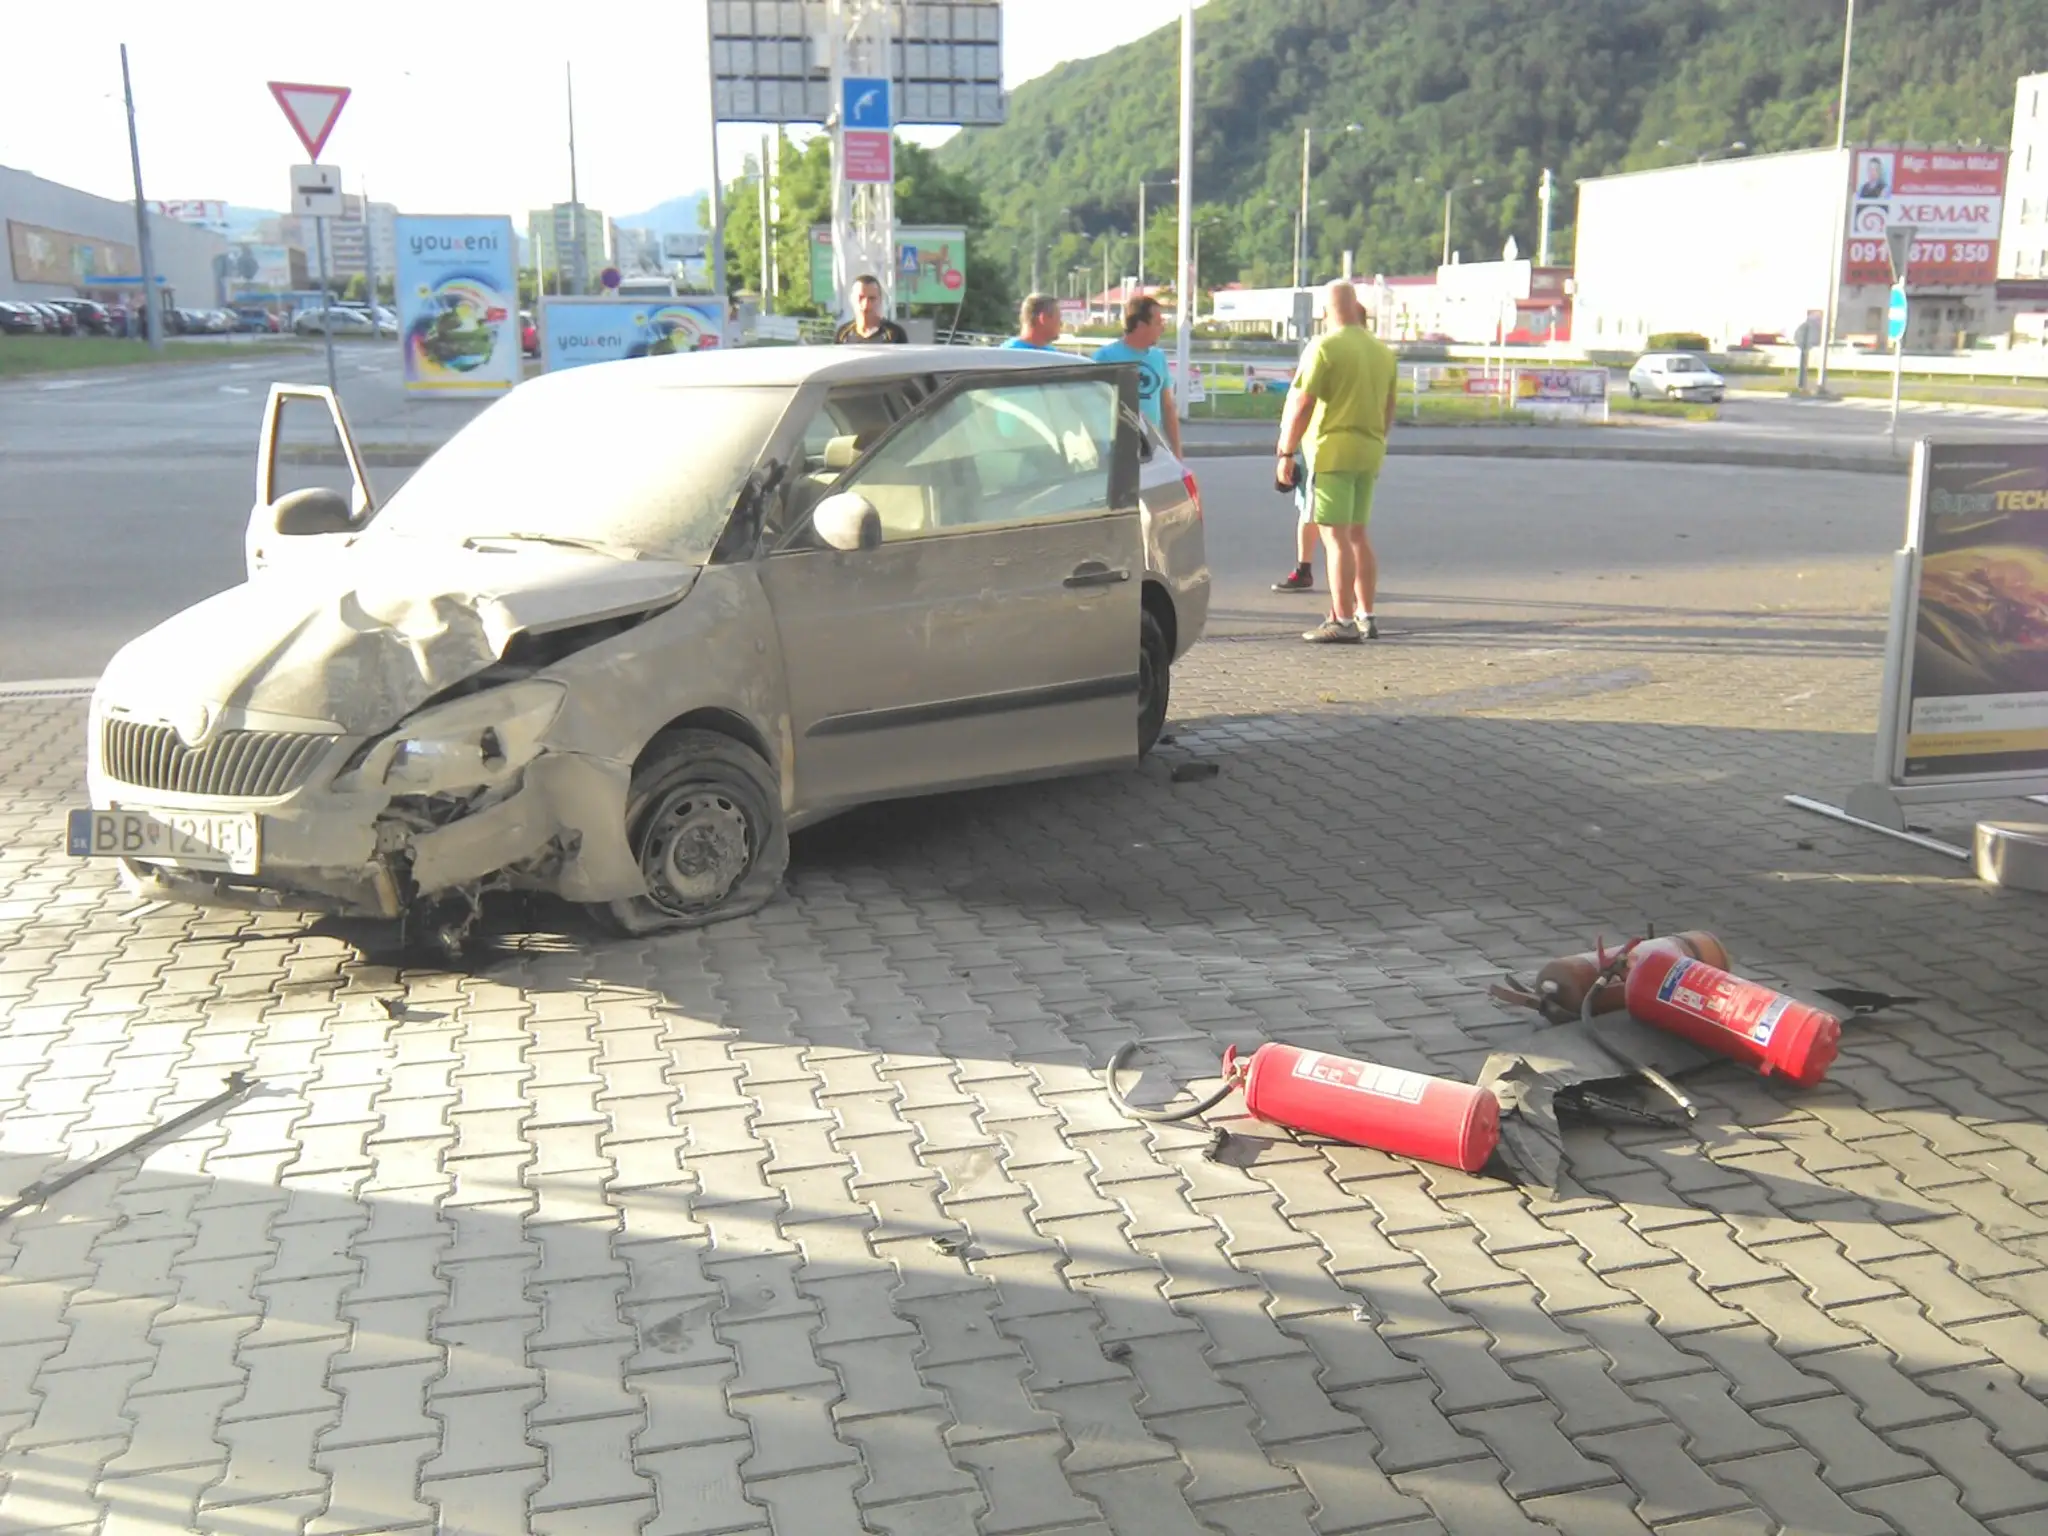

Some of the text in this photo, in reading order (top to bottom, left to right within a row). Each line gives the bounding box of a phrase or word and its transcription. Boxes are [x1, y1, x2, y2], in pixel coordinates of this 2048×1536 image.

[1897, 204, 1991, 223] XEMAR
[1951, 243, 1989, 262] 350
[96, 816, 143, 851] BB
